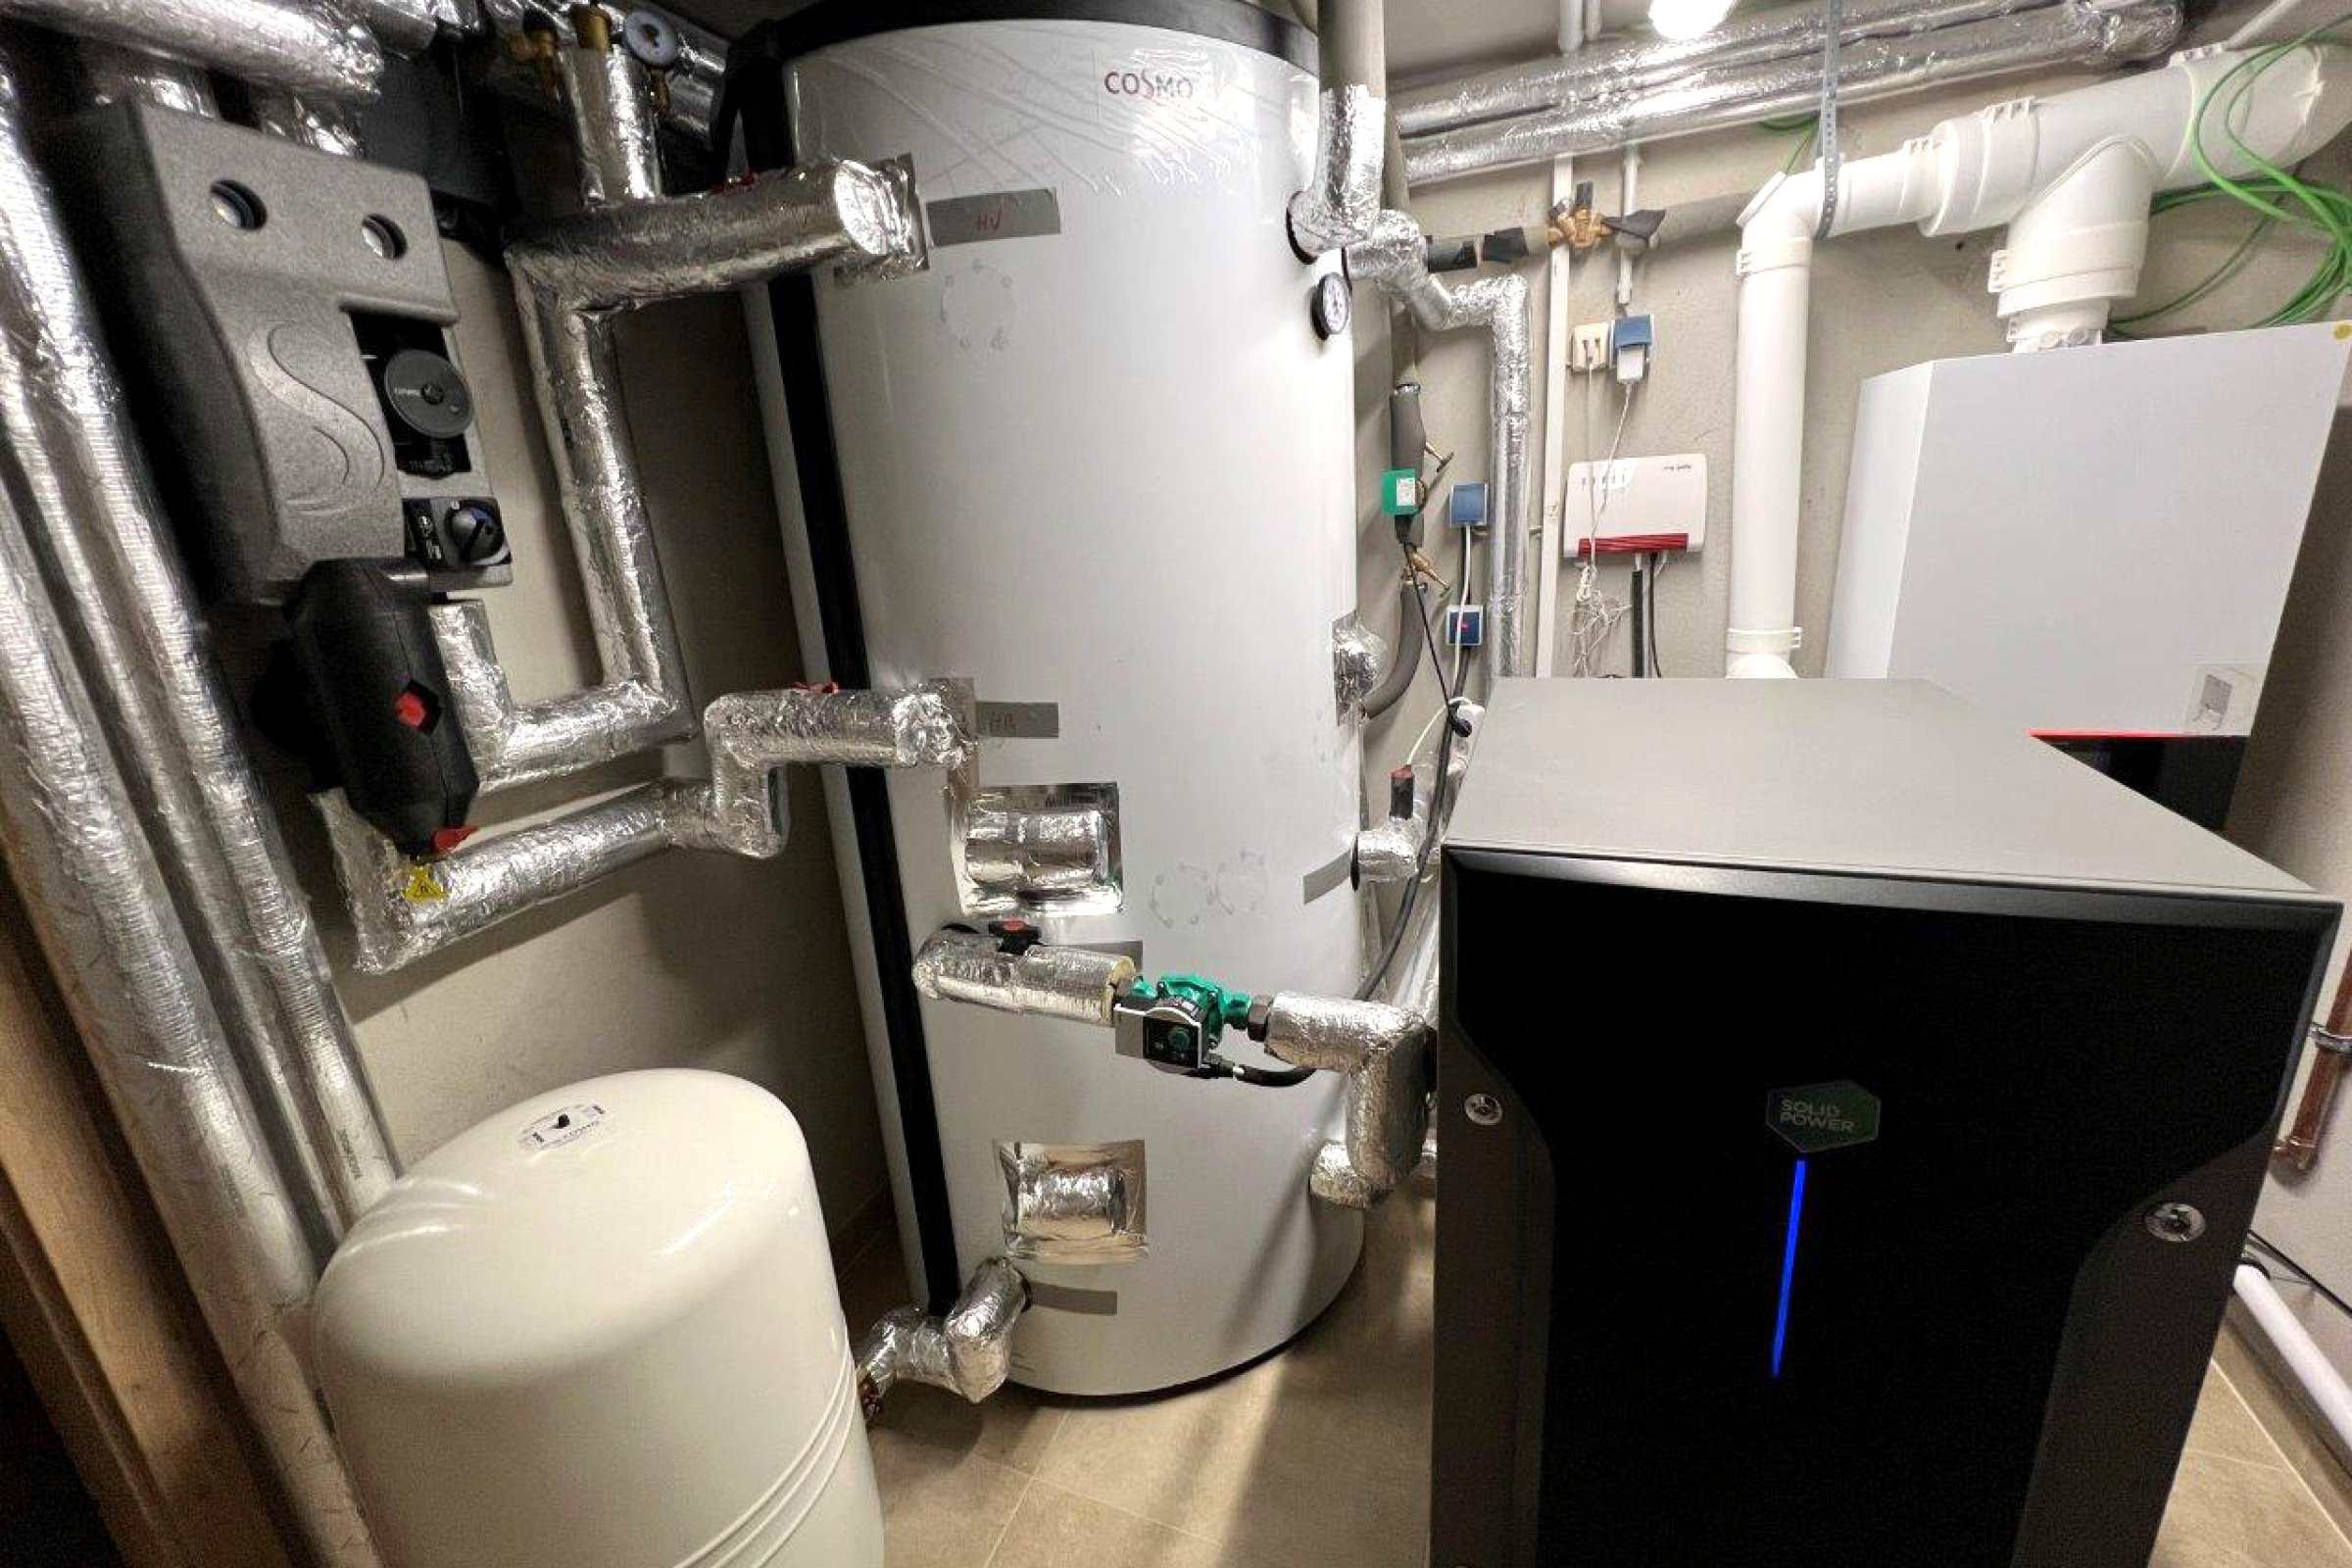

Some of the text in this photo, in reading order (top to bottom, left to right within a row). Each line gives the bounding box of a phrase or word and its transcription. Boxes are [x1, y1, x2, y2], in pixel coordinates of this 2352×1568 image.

[1103, 69, 1193, 99] COSMO
[1781, 1098, 1841, 1116] SOLID
[1780, 1111, 1855, 1133] POWER
